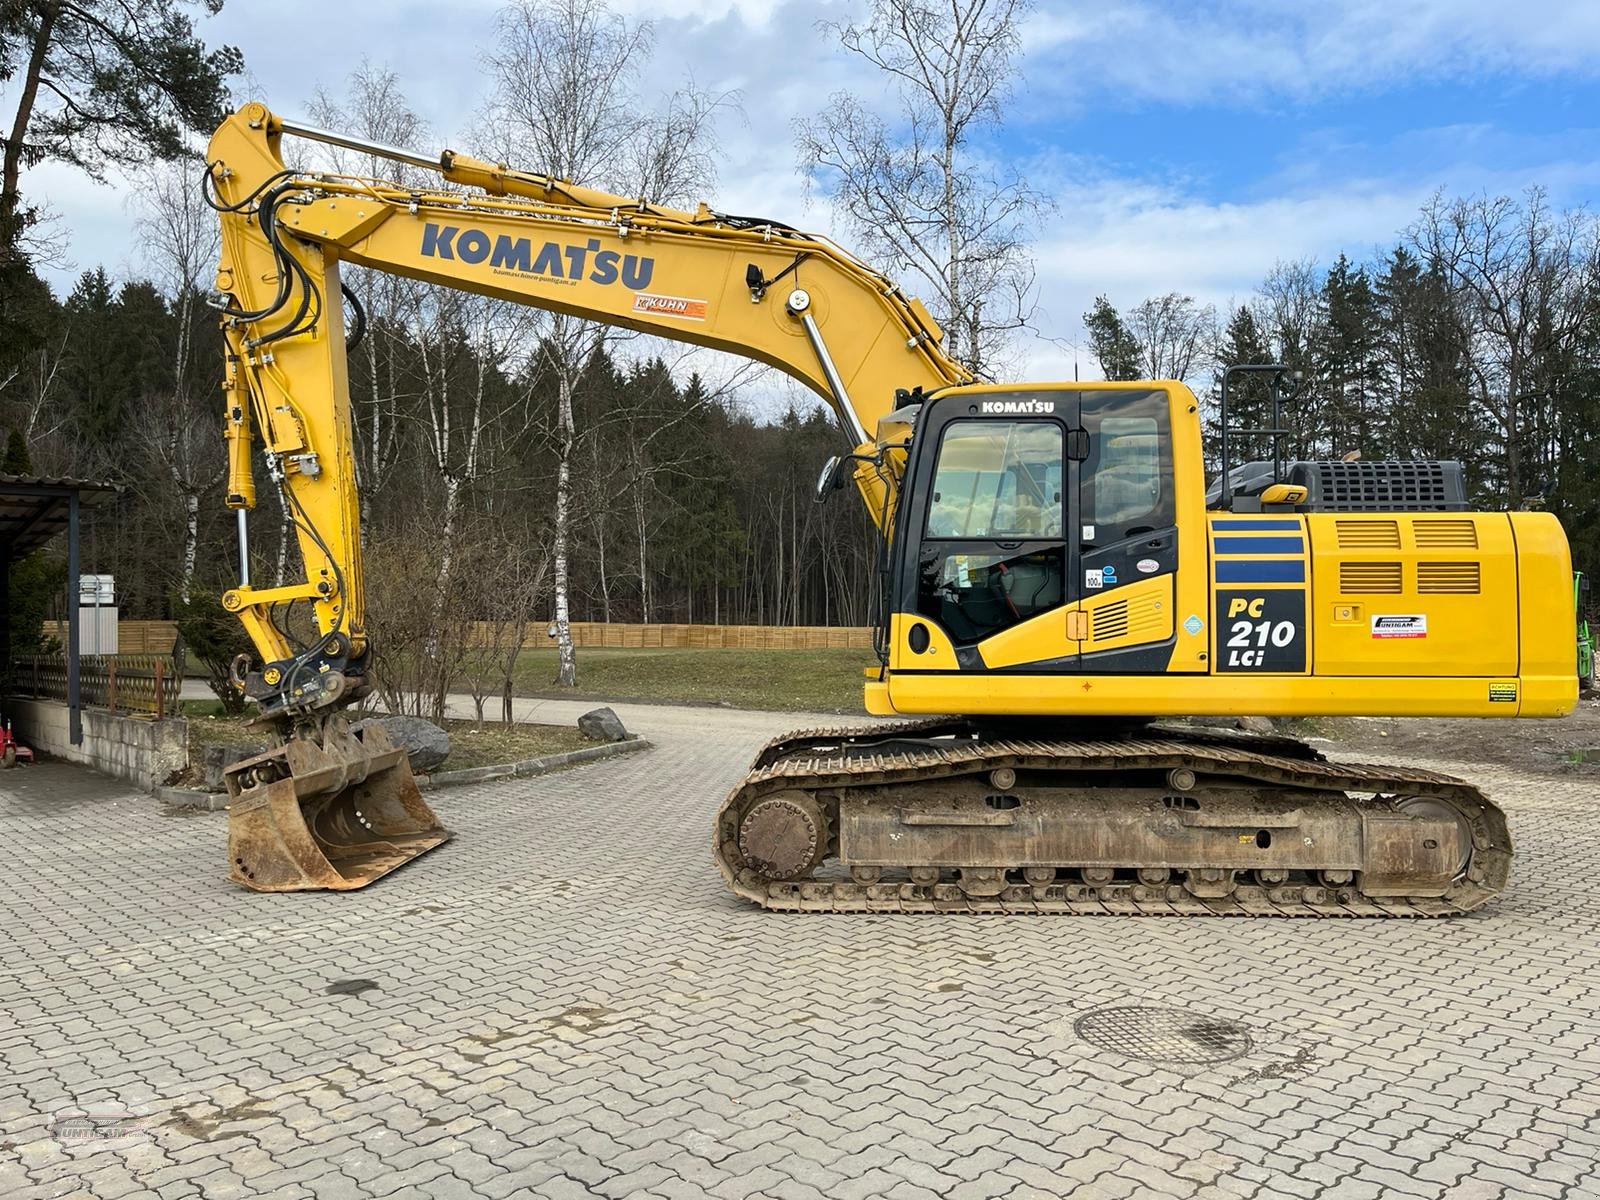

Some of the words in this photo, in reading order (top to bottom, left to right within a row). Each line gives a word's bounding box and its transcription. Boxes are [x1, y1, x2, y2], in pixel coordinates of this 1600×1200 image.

[421, 224, 655, 290] KOMATSU
[648, 297, 688, 311] KUHN
[982, 399, 1055, 414] KOMATSU
[1227, 597, 1265, 618] PC
[1227, 620, 1296, 648] 210
